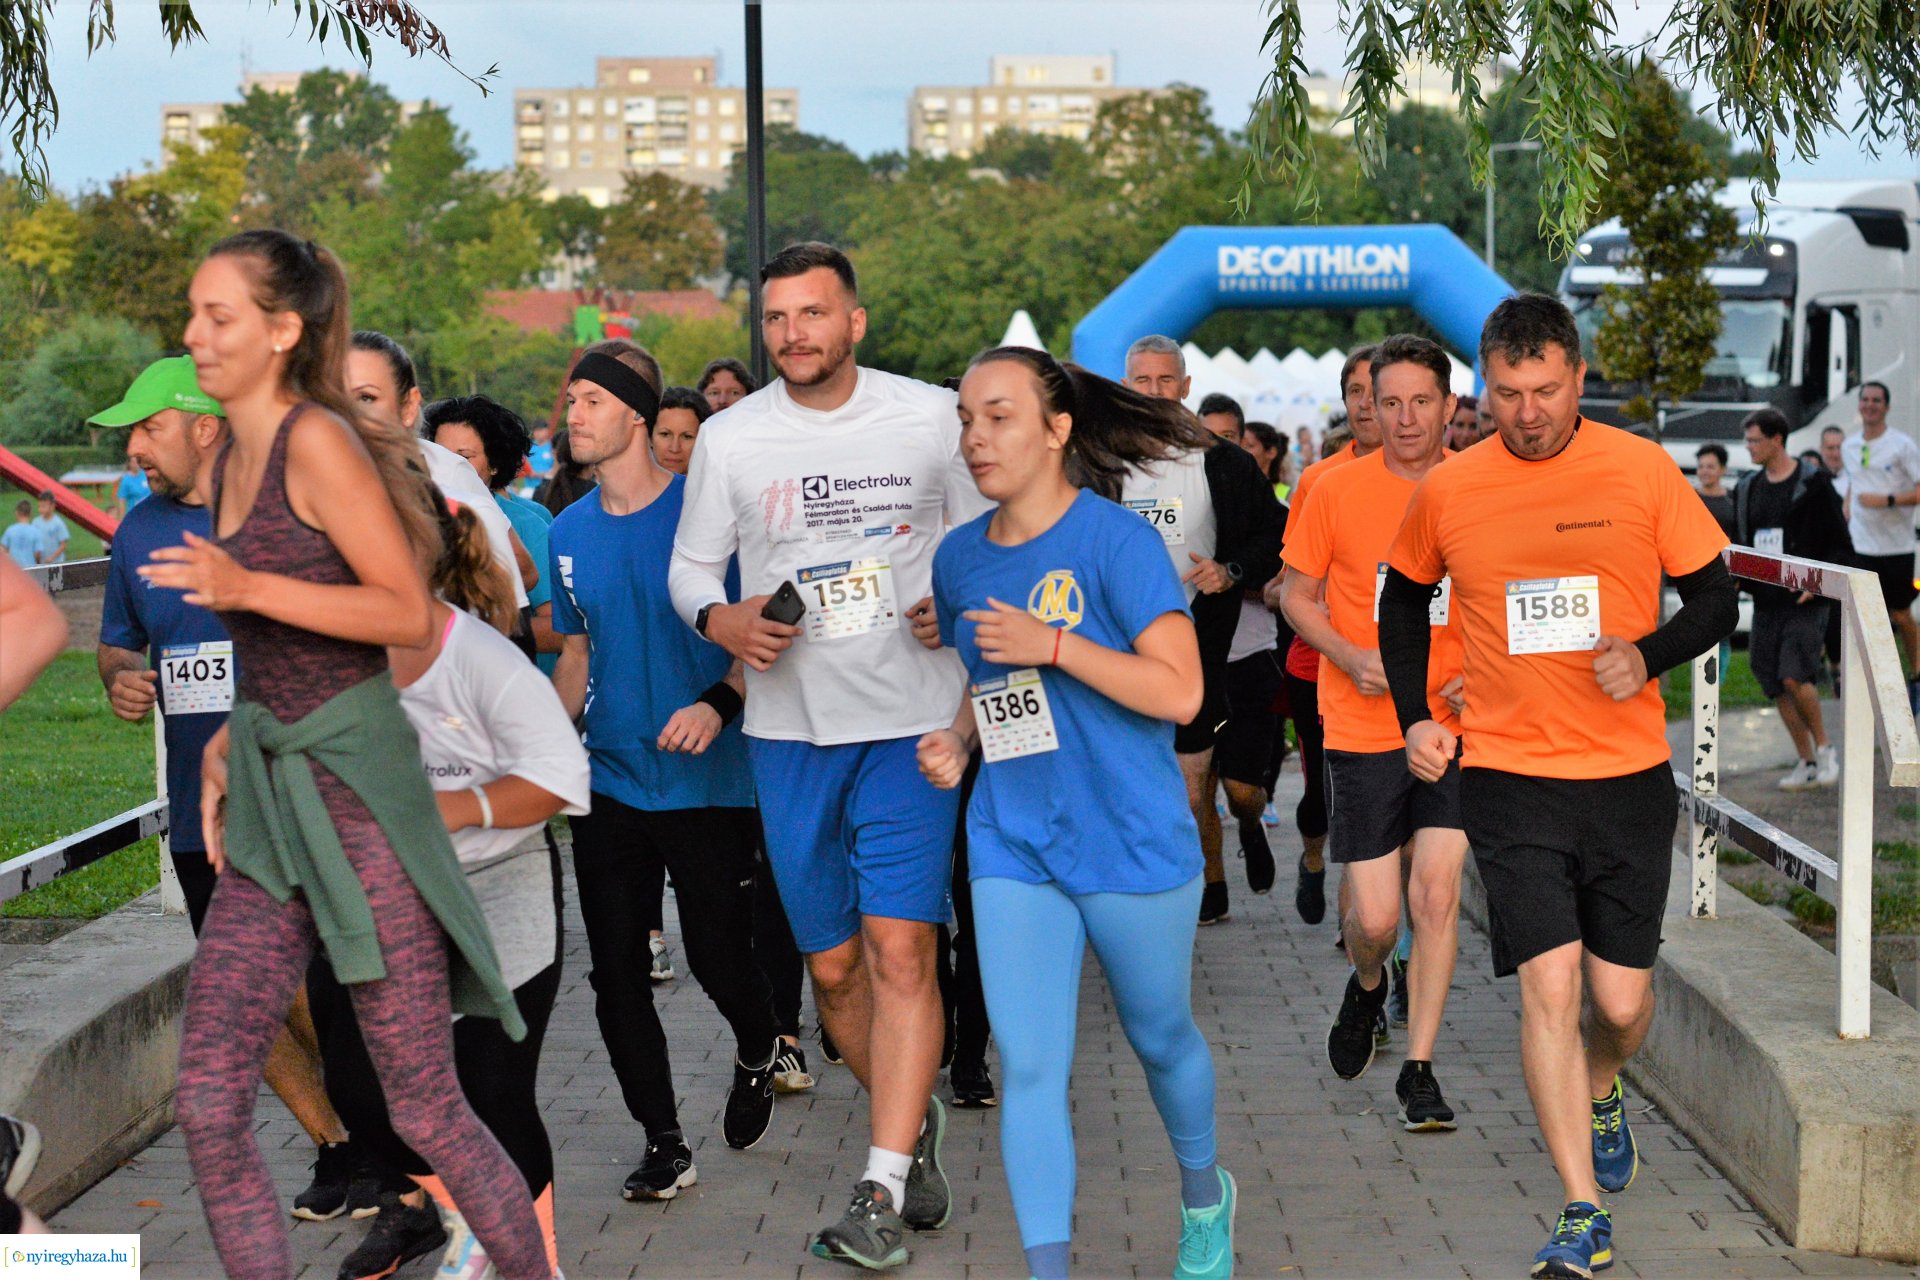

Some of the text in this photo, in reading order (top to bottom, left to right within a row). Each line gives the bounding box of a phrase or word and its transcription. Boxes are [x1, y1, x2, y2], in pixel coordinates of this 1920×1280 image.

[1218, 244, 1411, 276] DECATHLON
[834, 473, 912, 492] Electrolux
[803, 499, 855, 510] Nyíregyháza
[804, 503, 912, 518] Félmaraton és Családi futás
[806, 518, 825, 527] 2017.
[827, 517, 850, 526] május
[1139, 509, 1176, 525] 376
[1556, 519, 1605, 533] Continental
[813, 574, 881, 607] 1531
[1516, 593, 1590, 621] 1588
[167, 658, 227, 684] 1403
[980, 689, 1040, 724] 1386
[424, 762, 472, 778] trolux
